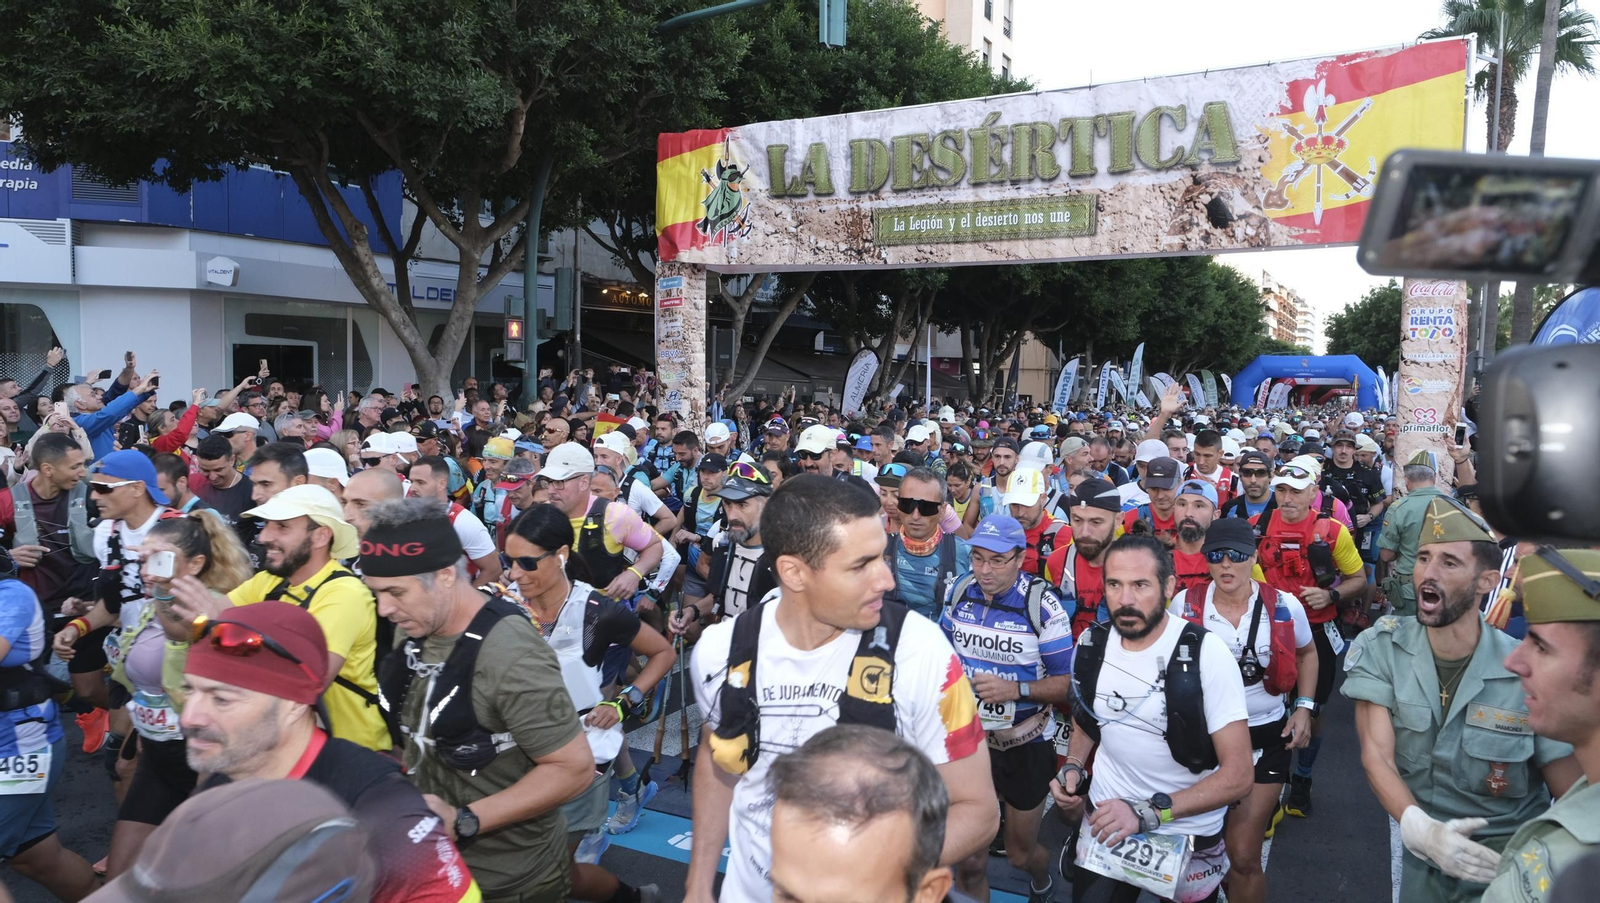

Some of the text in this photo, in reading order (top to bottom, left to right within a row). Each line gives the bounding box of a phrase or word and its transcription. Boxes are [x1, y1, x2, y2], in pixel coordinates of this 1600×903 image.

[766, 101, 1243, 197] LA DESÉRTICA
[893, 210, 1071, 233] La Legión y el desierto nos une
[1410, 315, 1454, 326] RENTA
[1410, 327, 1454, 340] TODO
[1403, 424, 1449, 434] primaflor
[971, 647, 1015, 663] ALUMINIO
[1110, 838, 1169, 871] 2297
